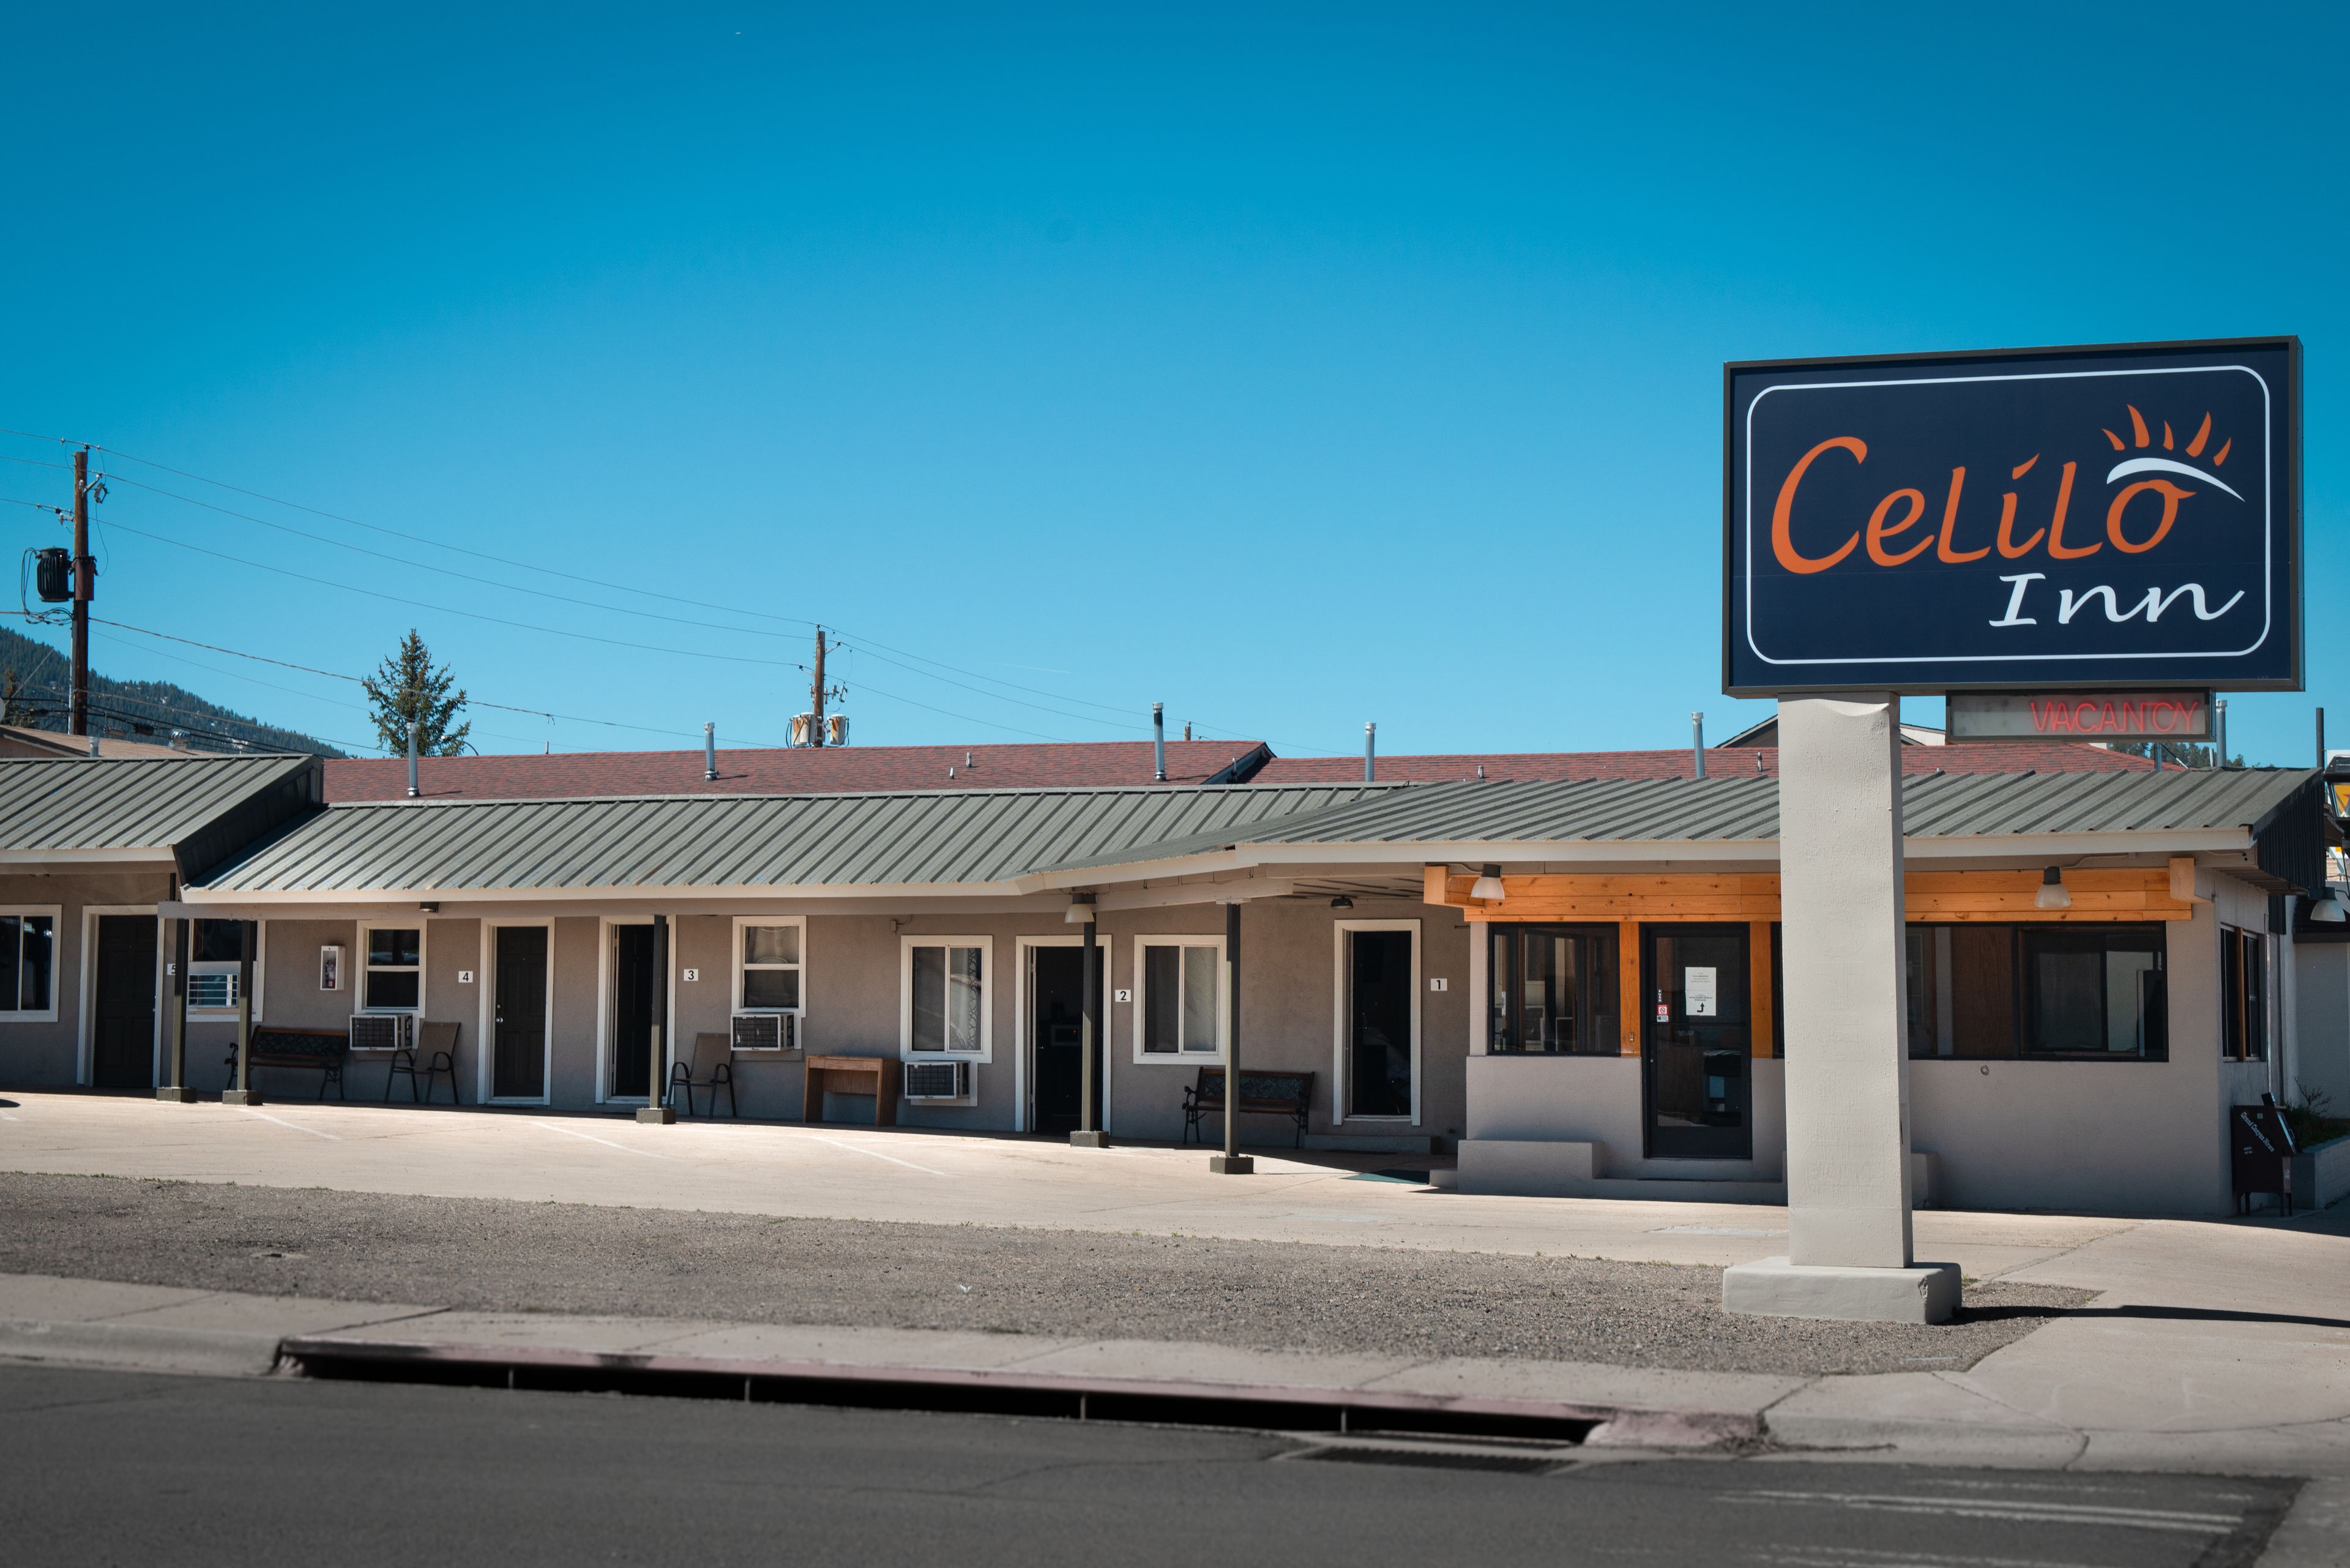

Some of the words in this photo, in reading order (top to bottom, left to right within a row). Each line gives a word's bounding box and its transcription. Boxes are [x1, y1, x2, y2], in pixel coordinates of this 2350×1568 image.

[1989, 572, 2245, 627] Inn
[2029, 700, 2199, 733] VACANCY
[171, 965, 176, 974] 5
[688, 970, 695, 980] 3
[463, 972, 469, 982] 4
[1436, 979, 1441, 990] 1
[1120, 990, 1127, 1001] 2
[2241, 1111, 2255, 1127] Grand
